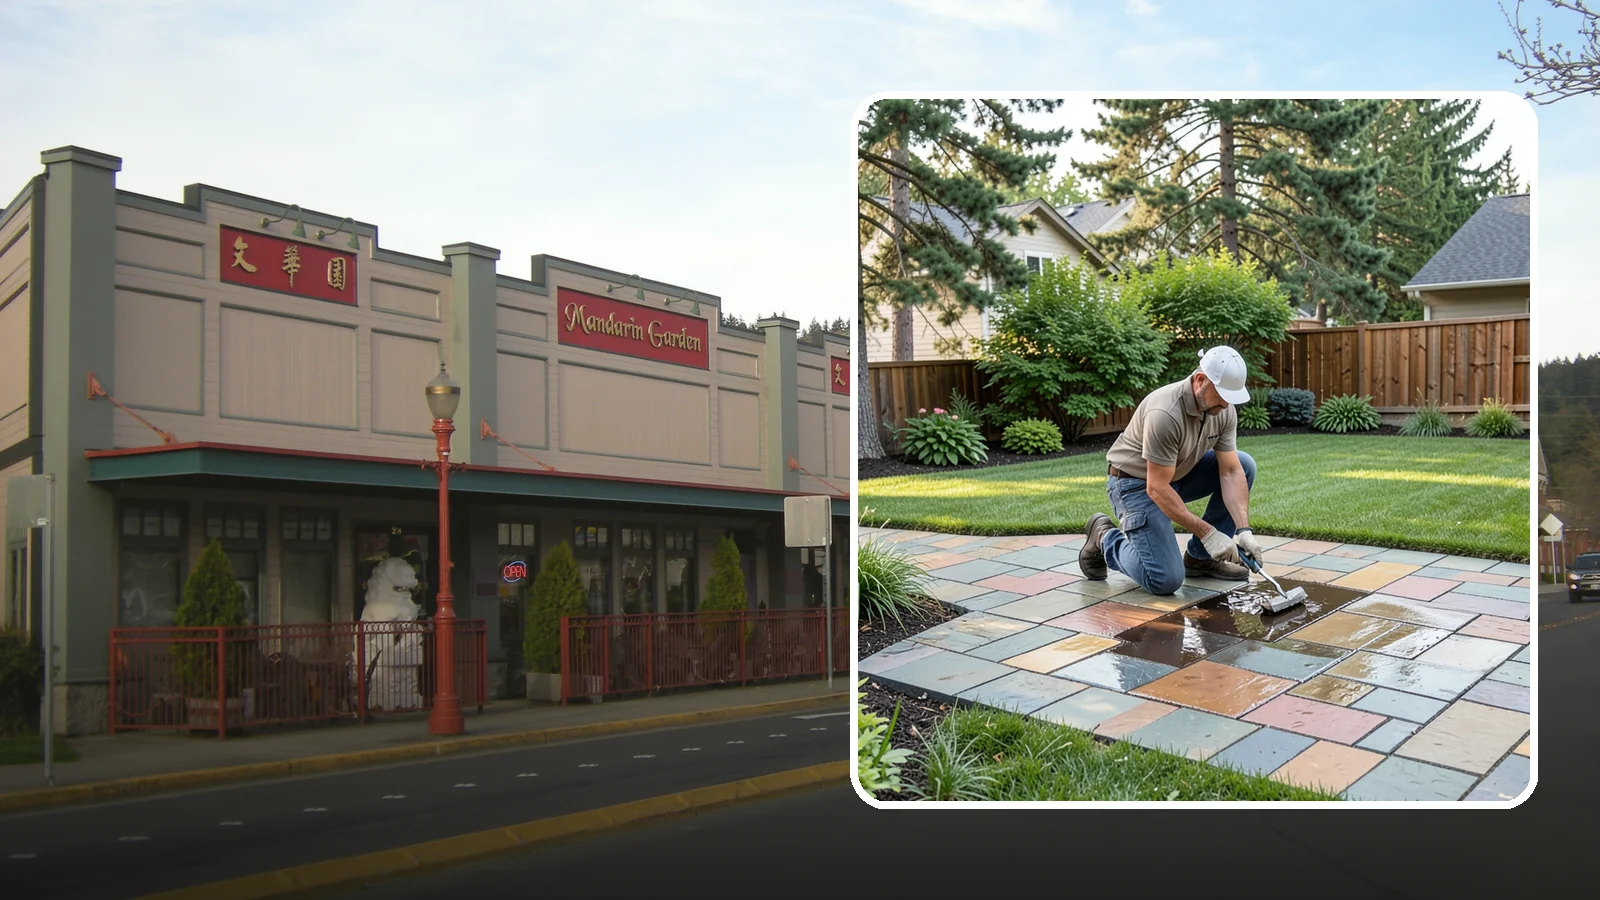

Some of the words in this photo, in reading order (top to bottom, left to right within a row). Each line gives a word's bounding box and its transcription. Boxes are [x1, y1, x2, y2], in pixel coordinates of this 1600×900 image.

[564, 302, 644, 341] Mandarin
[648, 320, 702, 352] Garden
[503, 565, 527, 578] OPEN
